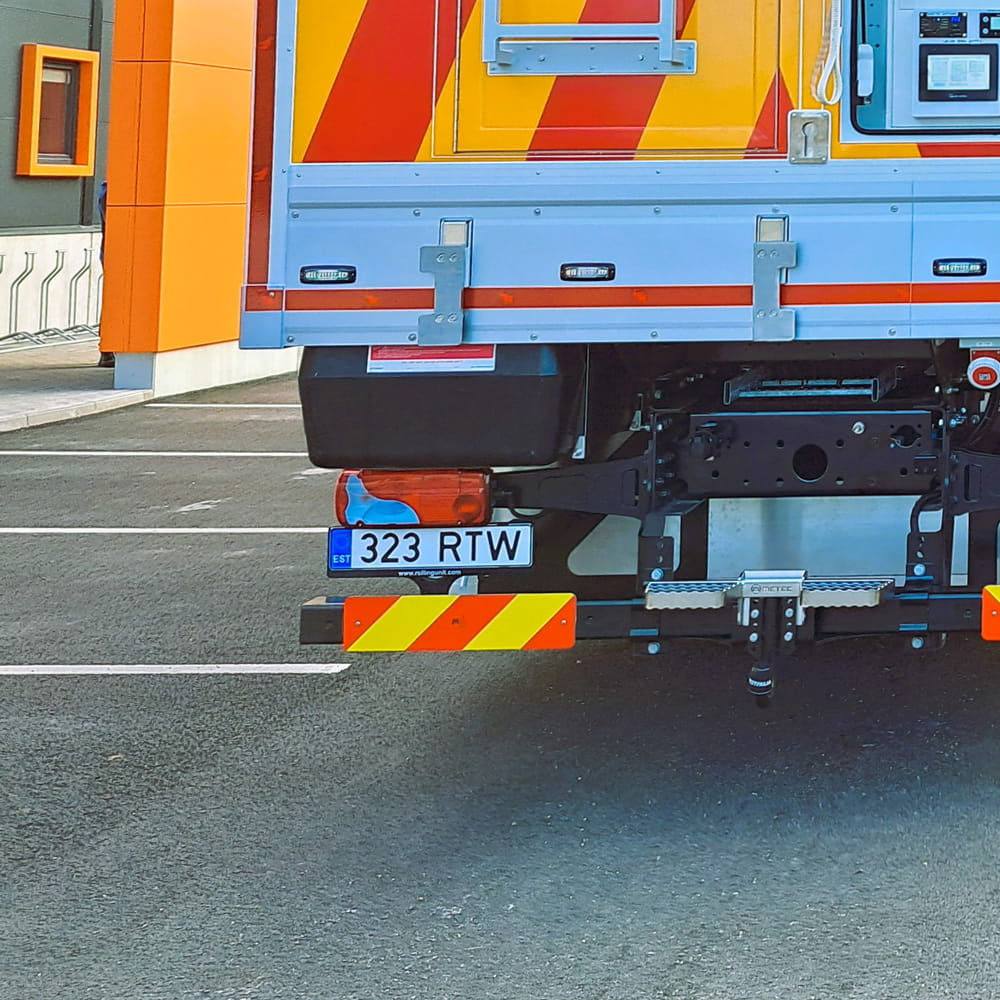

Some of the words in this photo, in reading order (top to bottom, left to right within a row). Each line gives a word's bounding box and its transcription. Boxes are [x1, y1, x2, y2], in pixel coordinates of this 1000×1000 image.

[360, 532, 421, 564] 323
[439, 530, 521, 562] RTW
[333, 554, 351, 564] EST
